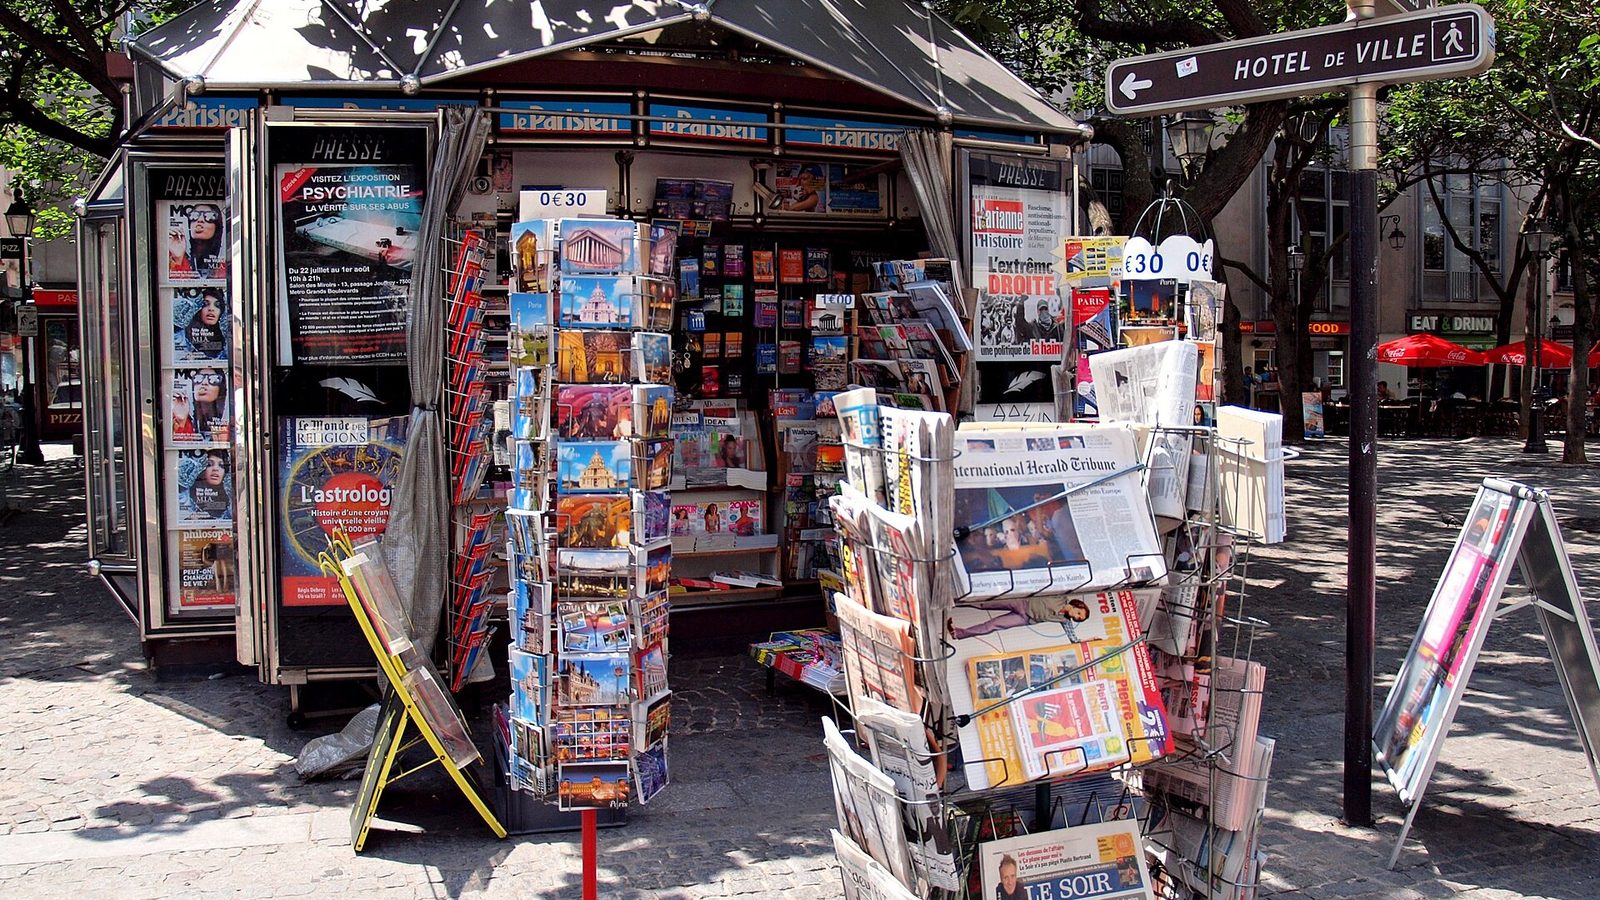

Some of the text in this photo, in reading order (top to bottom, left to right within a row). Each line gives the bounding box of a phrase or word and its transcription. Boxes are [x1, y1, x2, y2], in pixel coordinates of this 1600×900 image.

[1234, 34, 1426, 81] HOTEL DE VILLE
[530, 105, 618, 131] Parisien
[678, 110, 756, 140] Parisien
[312, 135, 384, 160] PRESSE
[344, 174, 400, 182] L'EXPOSITION
[998, 162, 1047, 186] PRESSE
[165, 176, 225, 196] PRESSE
[303, 185, 410, 200] PSYCHIATRIE
[318, 203, 348, 212] VÉRITÉ
[387, 202, 409, 210] ABUS
[975, 199, 1023, 230] Marianne
[975, 234, 1023, 249] l'Histoire
[310, 267, 329, 275] juillet
[350, 281, 373, 289] passage
[989, 275, 1055, 296] DROITE
[1412, 316, 1493, 331] EAT & DRINK
[981, 346, 993, 355] une
[994, 344, 1022, 357] politique
[1023, 344, 1030, 355] de
[1032, 341, 1039, 355] la
[50, 414, 82, 424] PIZZ
[298, 420, 308, 430] Le
[311, 420, 350, 431] Monde
[297, 433, 366, 443] RELIGIONS
[1026, 459, 1068, 475] Herald
[1070, 457, 1116, 472] Tribune
[1132, 644, 1148, 687] XCEPTIONNELLE
[1113, 679, 1133, 721] Pierre
[1192, 676, 1200, 708] MASSA
[610, 800, 628, 808] Paris
[1073, 854, 1091, 862] Bertrand
[1024, 882, 1053, 900] LE
[1059, 872, 1113, 899] SOIR
